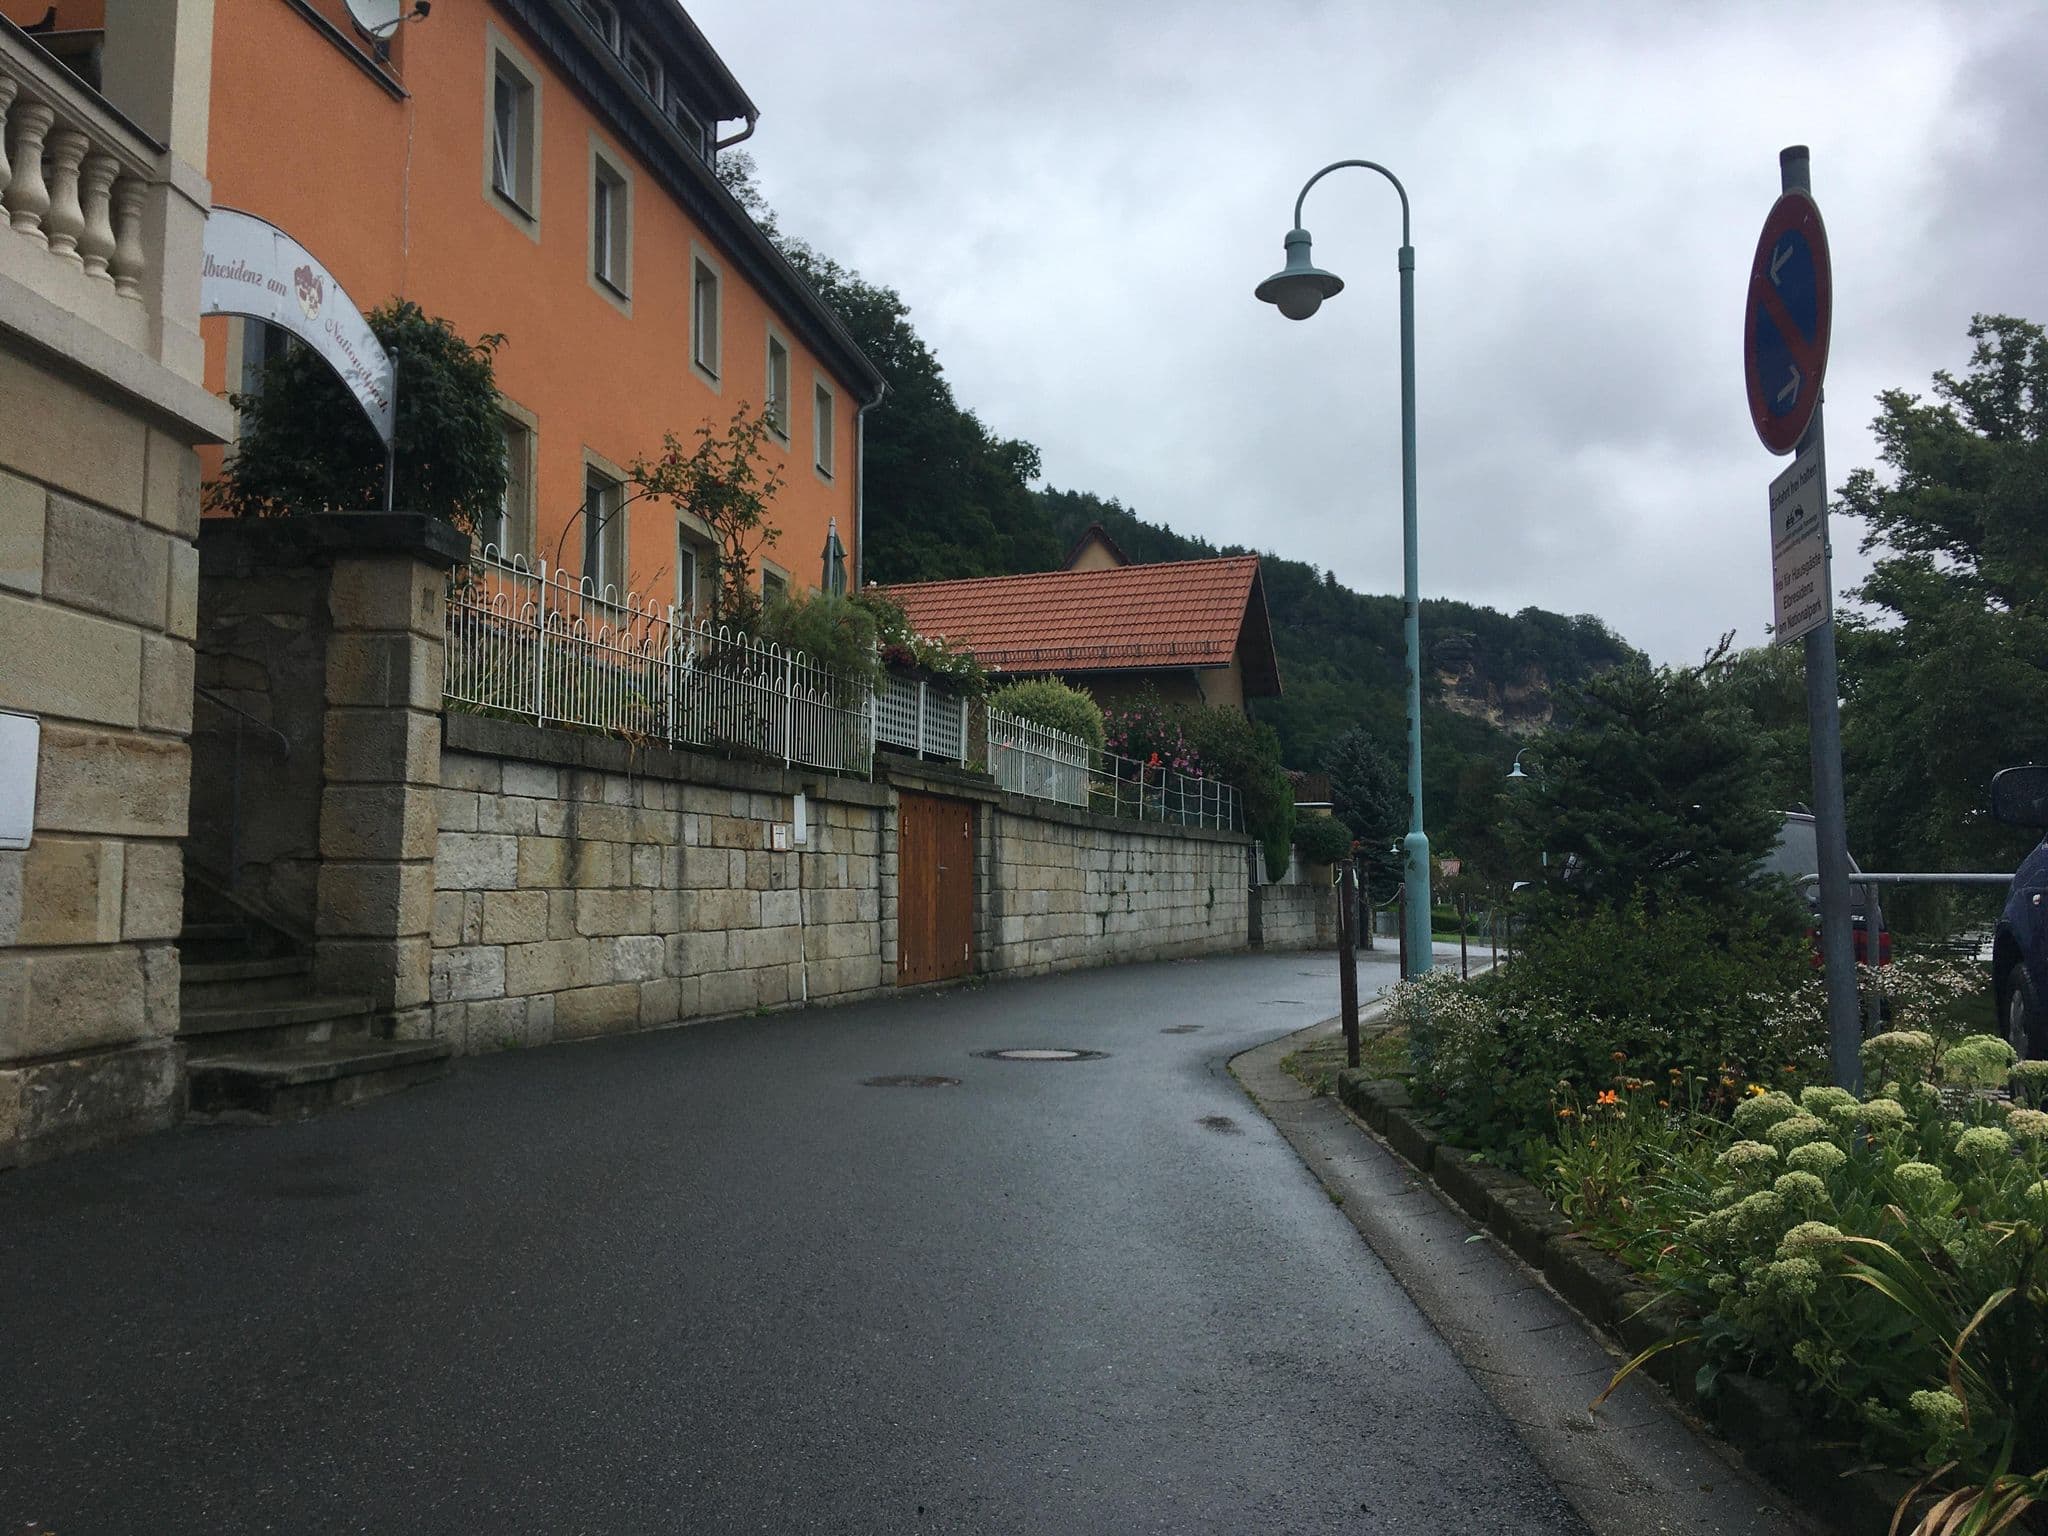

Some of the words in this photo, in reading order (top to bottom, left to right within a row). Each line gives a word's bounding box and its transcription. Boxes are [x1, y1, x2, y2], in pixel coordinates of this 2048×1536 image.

[203, 254, 263, 287] lbresidenz
[267, 278, 287, 297] am
[1783, 580, 1814, 610] Elbresidenz
